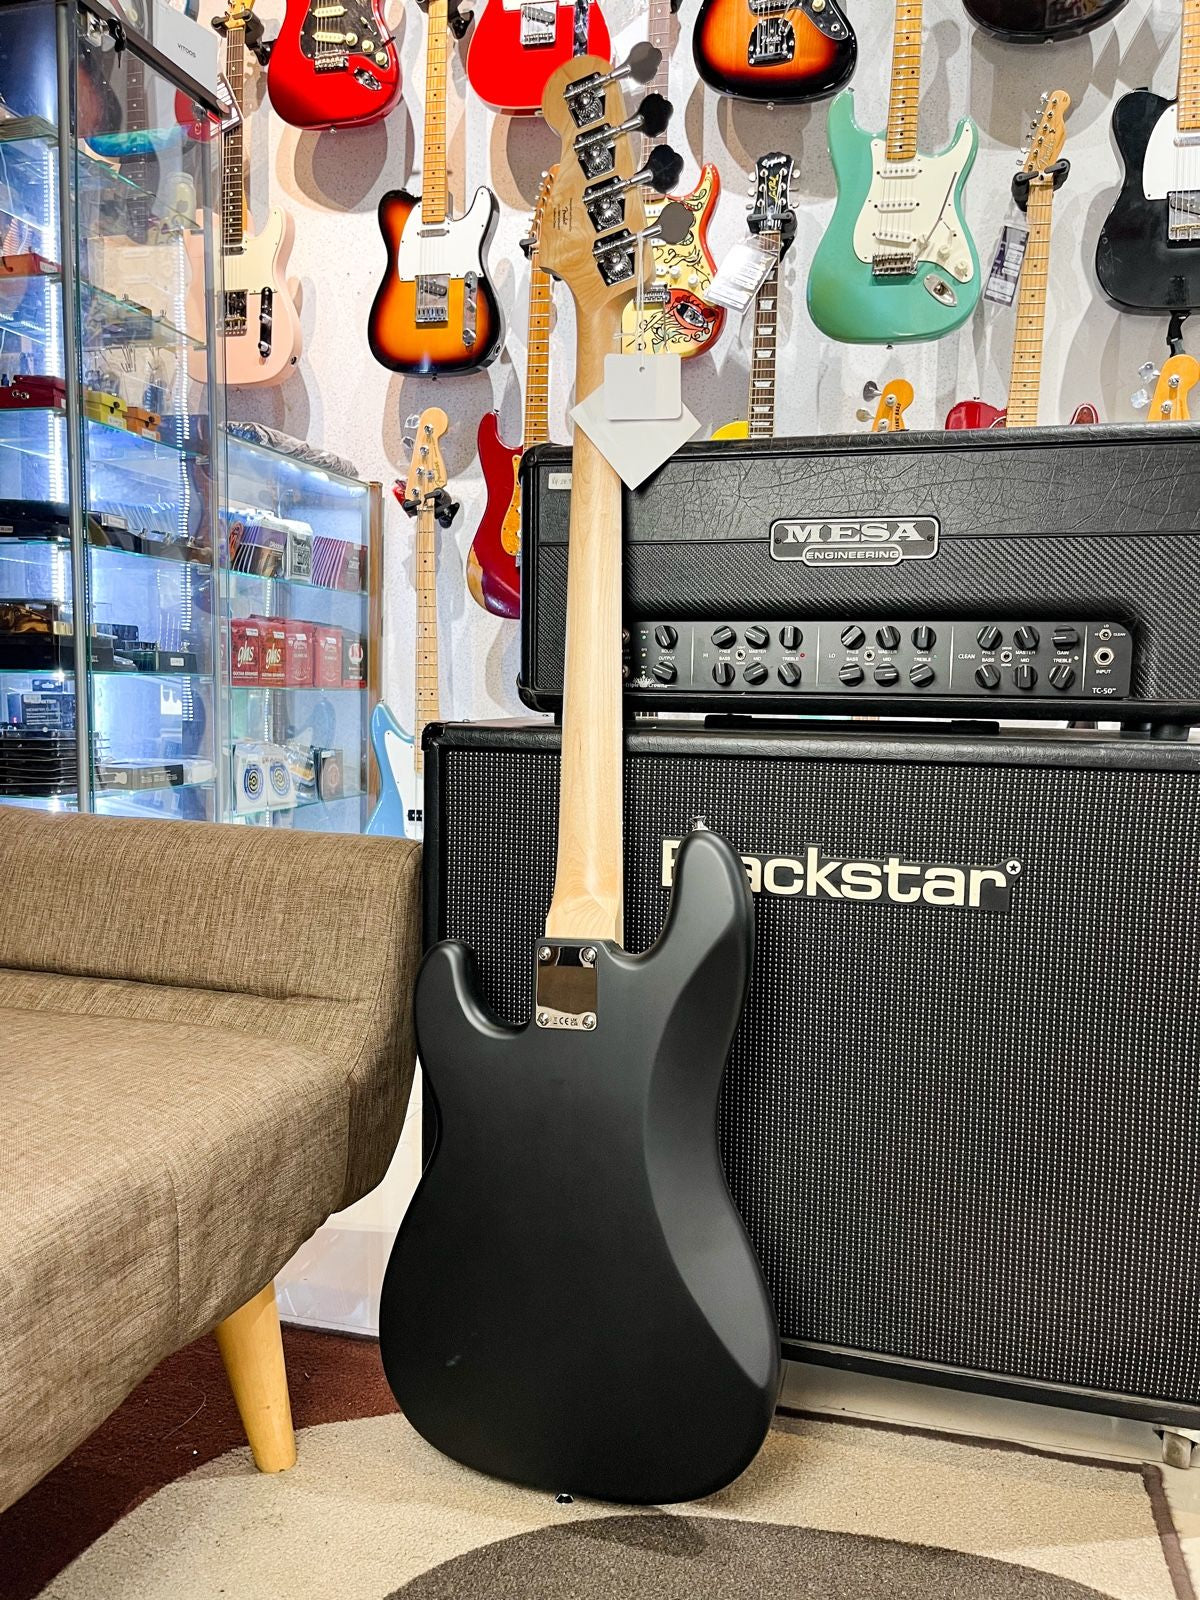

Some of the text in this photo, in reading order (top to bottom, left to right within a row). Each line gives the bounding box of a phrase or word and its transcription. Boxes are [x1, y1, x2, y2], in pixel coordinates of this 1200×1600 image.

[783, 522, 925, 544] MESA
[806, 551, 899, 560] ENGINEERING
[662, 839, 1006, 907] ackstar
